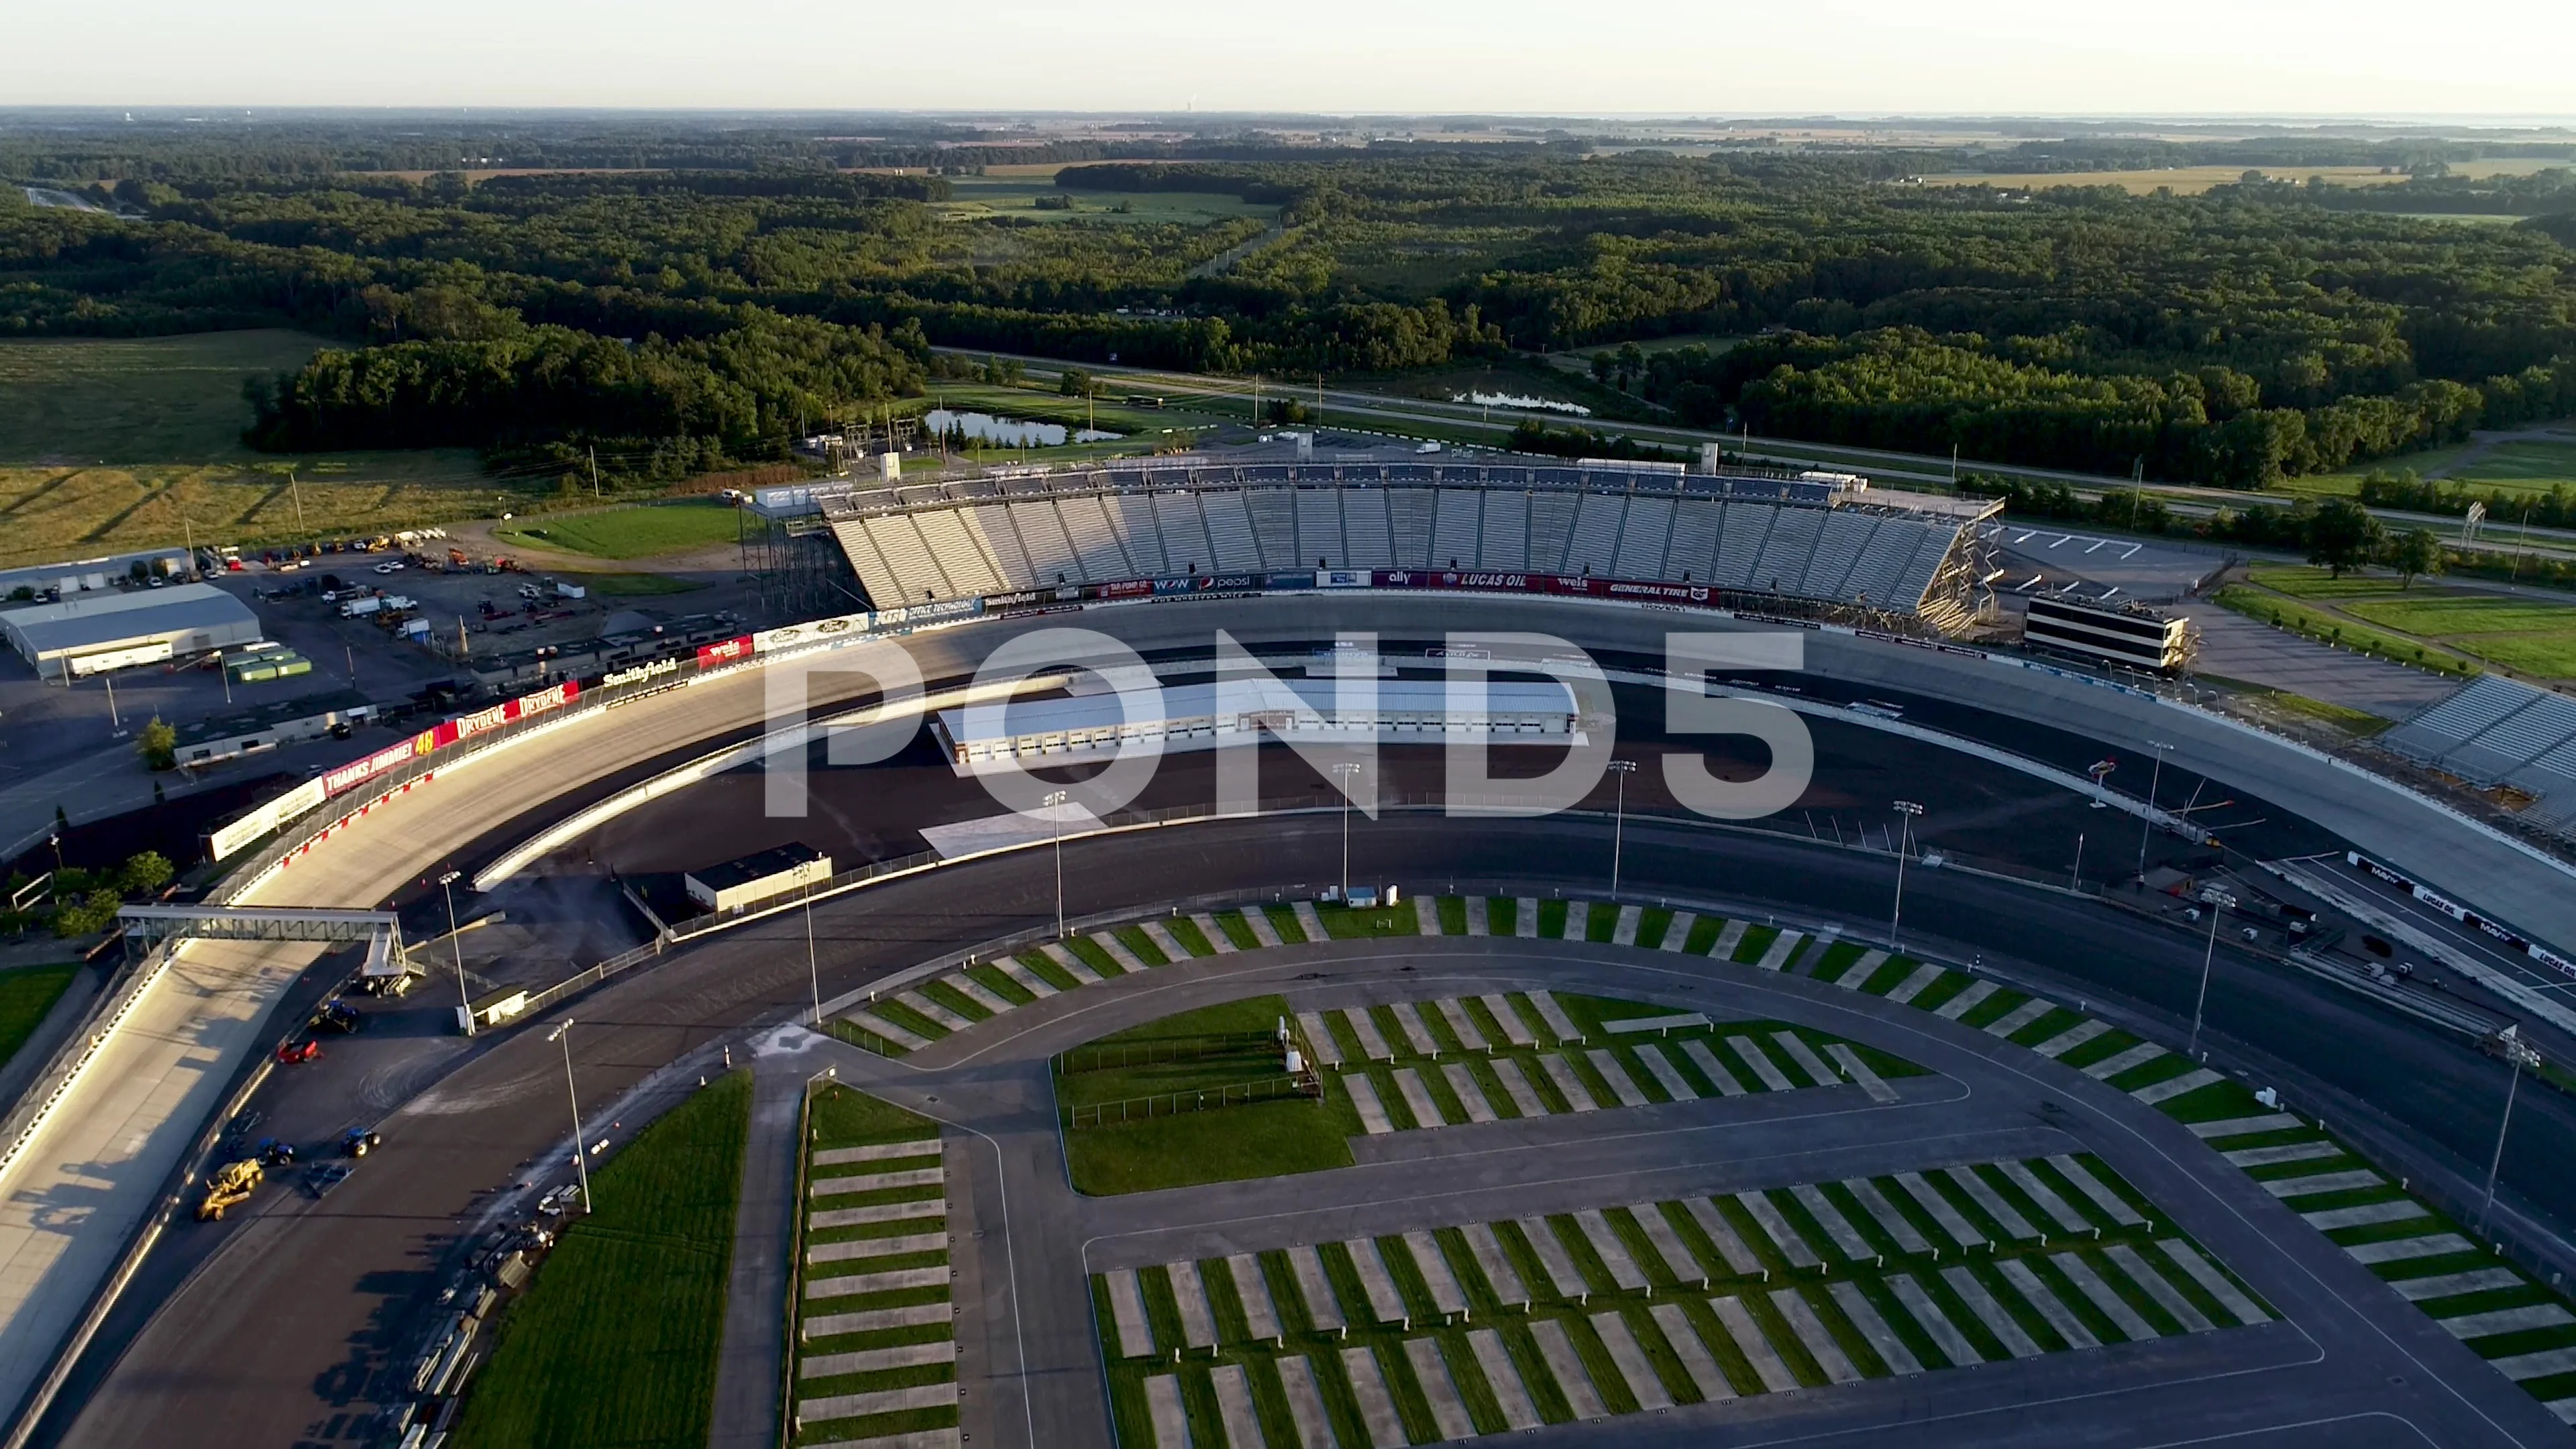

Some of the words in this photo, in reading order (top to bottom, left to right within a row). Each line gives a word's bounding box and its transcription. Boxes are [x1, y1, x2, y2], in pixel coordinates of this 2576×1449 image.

[1218, 576, 1249, 586] pepsi
[1389, 571, 1411, 584] ally
[1460, 574, 1504, 586] LUCAS
[1506, 575, 1527, 586] OIL
[1558, 577, 1588, 588] weis
[1610, 584, 1660, 594] GENERAL
[1662, 588, 1689, 597] TIRE
[909, 604, 932, 616] OFFICE
[933, 598, 976, 612] TECHNOLOGY
[985, 592, 1036, 606] Smithfield
[820, 621, 845, 633] Ford
[603, 657, 678, 688] Smithfield
[519, 684, 566, 718] DRYDENE
[456, 704, 506, 739] DRYDENE
[326, 761, 369, 792] THANKS
[370, 741, 413, 773] JIMMIE!
[415, 730, 433, 756] 48
[2422, 893, 2444, 910] LUCAS
[2444, 904, 2455, 915] OIL
[2538, 953, 2564, 970] LUCAS
[2564, 965, 2576, 977] OIL
